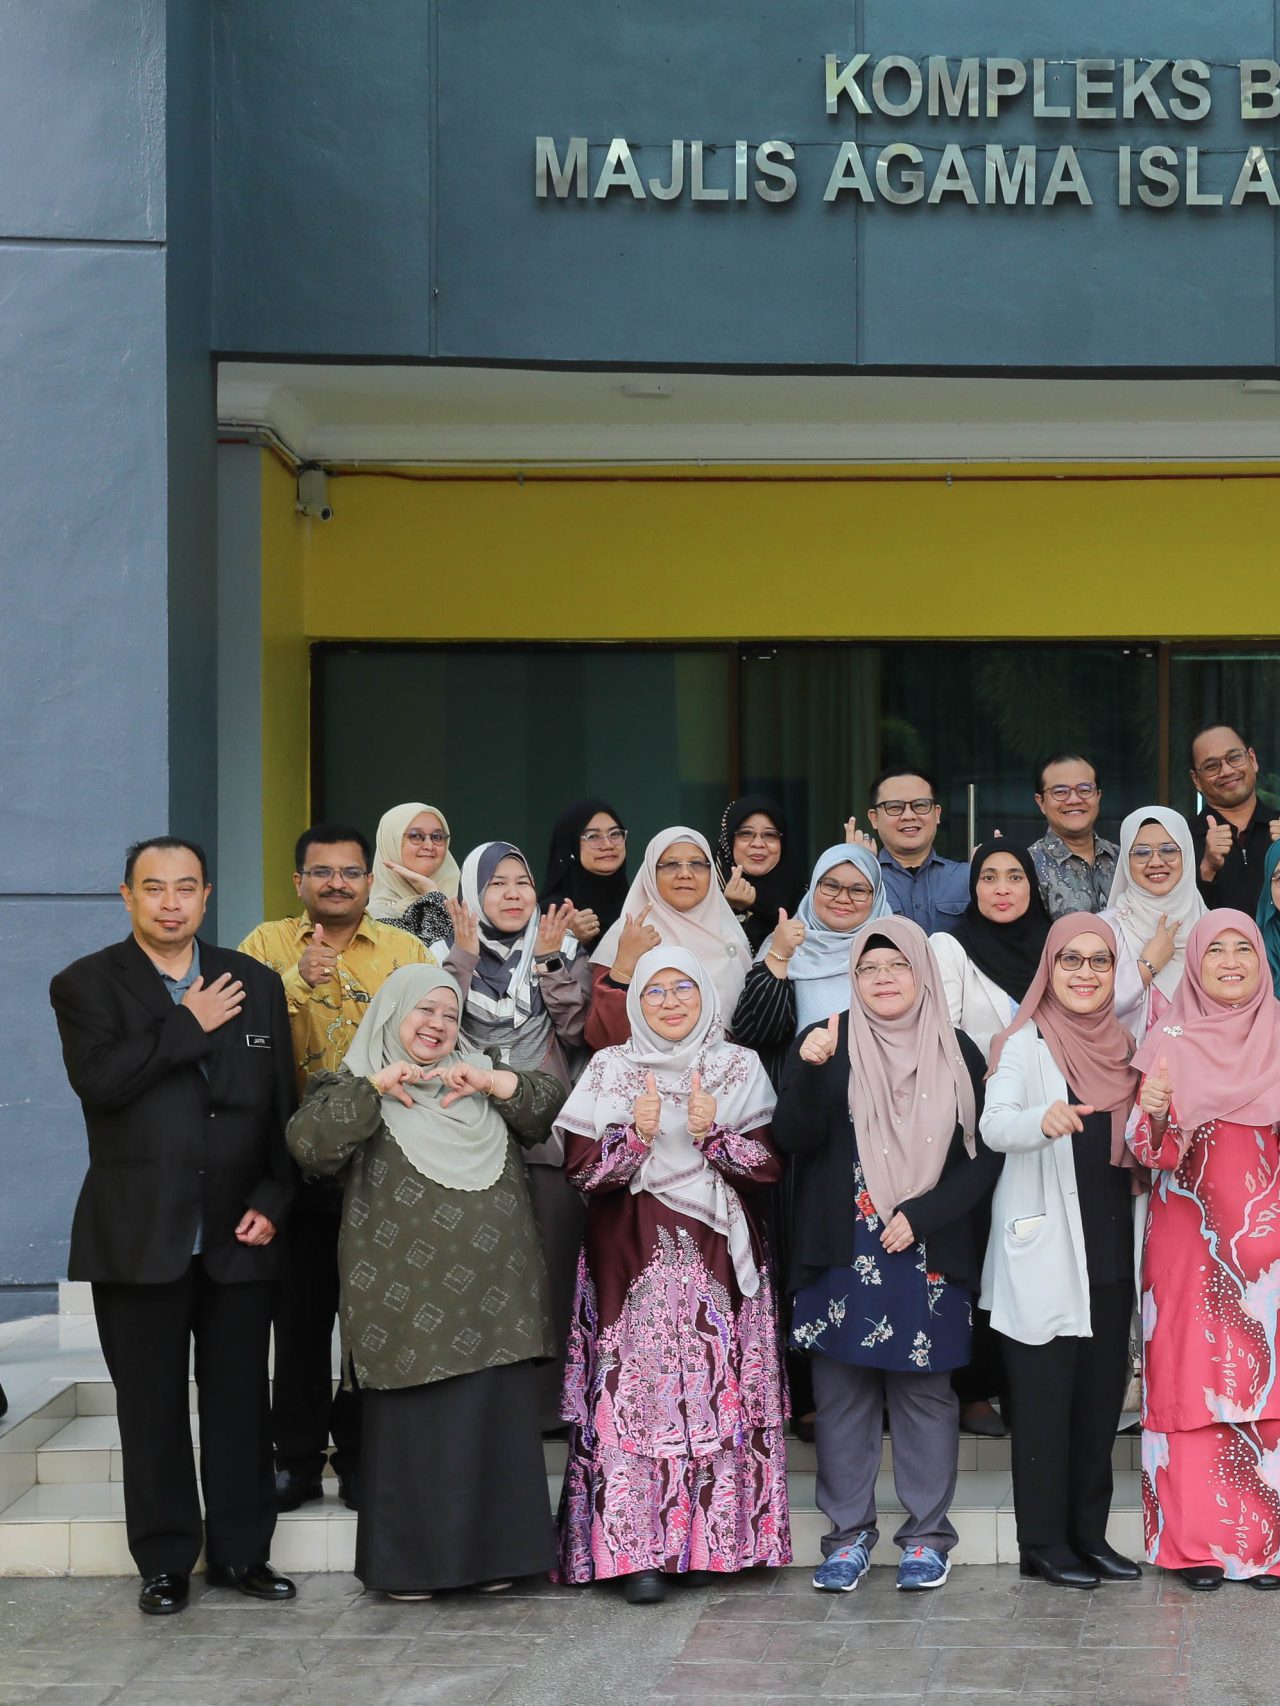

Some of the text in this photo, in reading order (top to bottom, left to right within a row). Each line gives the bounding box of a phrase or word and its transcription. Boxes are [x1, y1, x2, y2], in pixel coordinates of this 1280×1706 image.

[825, 53, 1212, 120] KOMPLEKS
[535, 136, 797, 202] MAJLIS
[823, 141, 1093, 205] AGAMA
